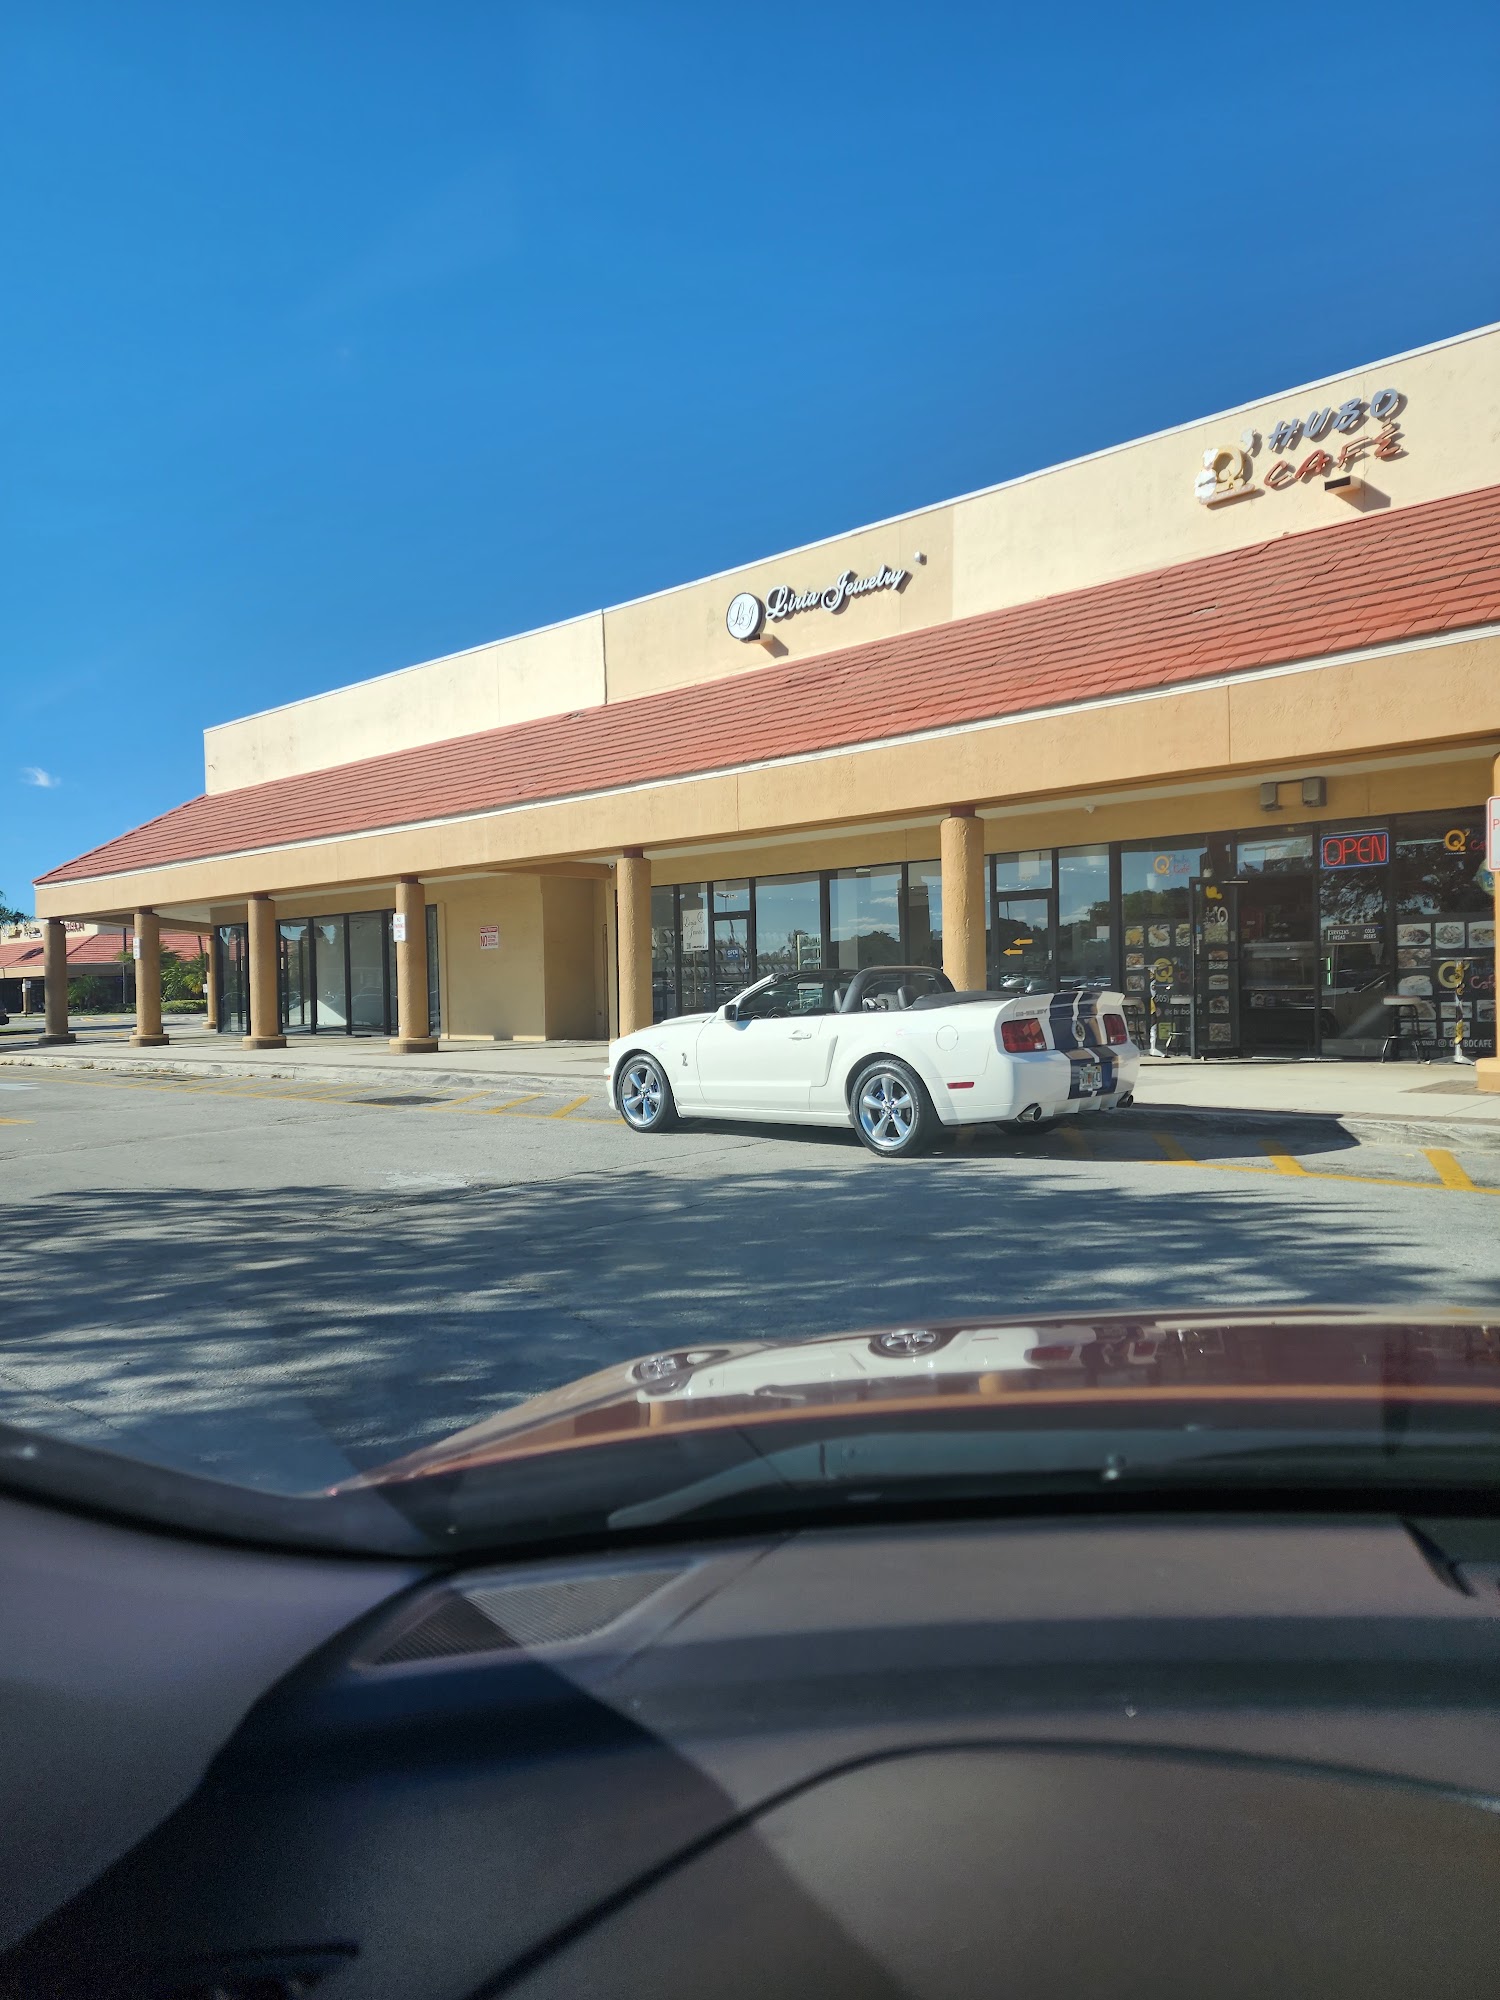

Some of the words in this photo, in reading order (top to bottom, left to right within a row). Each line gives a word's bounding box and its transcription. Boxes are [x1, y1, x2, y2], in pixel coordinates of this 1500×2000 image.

[1268, 388, 1400, 450] HUBO
[765, 585, 820, 620] Liria
[821, 564, 906, 612] Jewelry
[1324, 835, 1387, 866] OPEN
